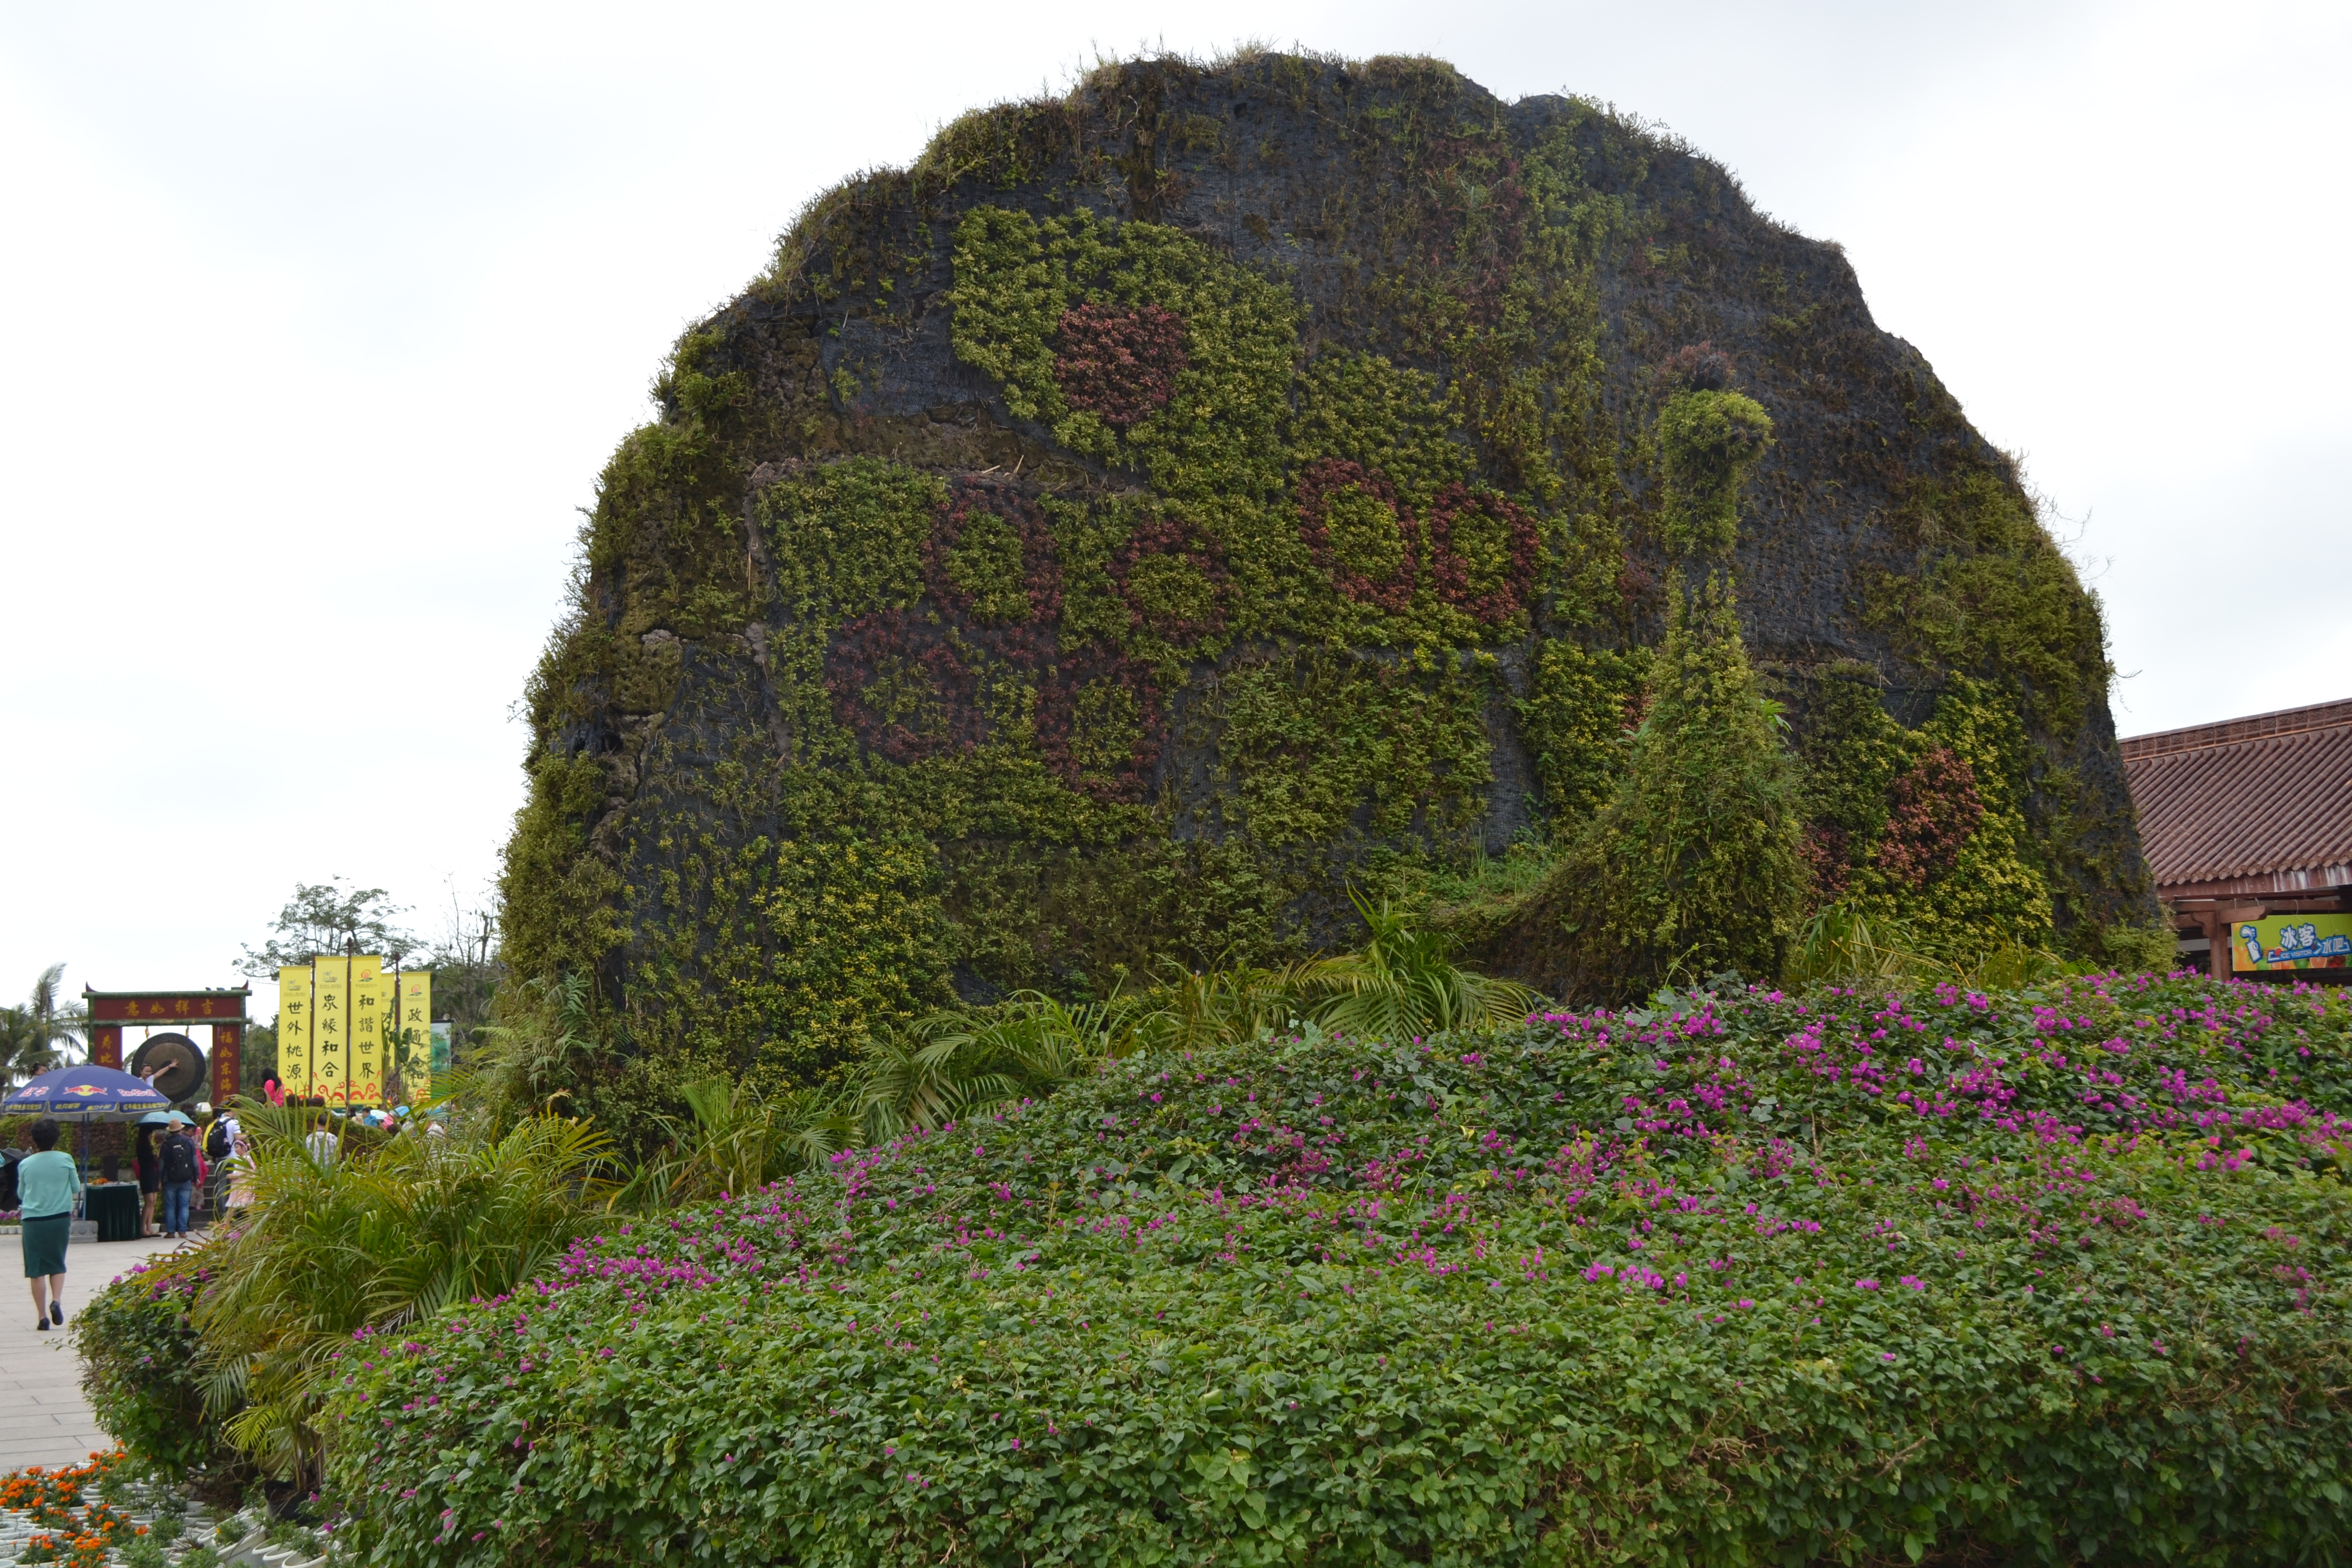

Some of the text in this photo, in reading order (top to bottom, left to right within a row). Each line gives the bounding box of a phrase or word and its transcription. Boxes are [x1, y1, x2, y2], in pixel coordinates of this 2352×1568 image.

[2281, 923, 2315, 948] 冰客
[286, 1001, 304, 1080] 世外桃源
[358, 994, 375, 1079] 和諧世界
